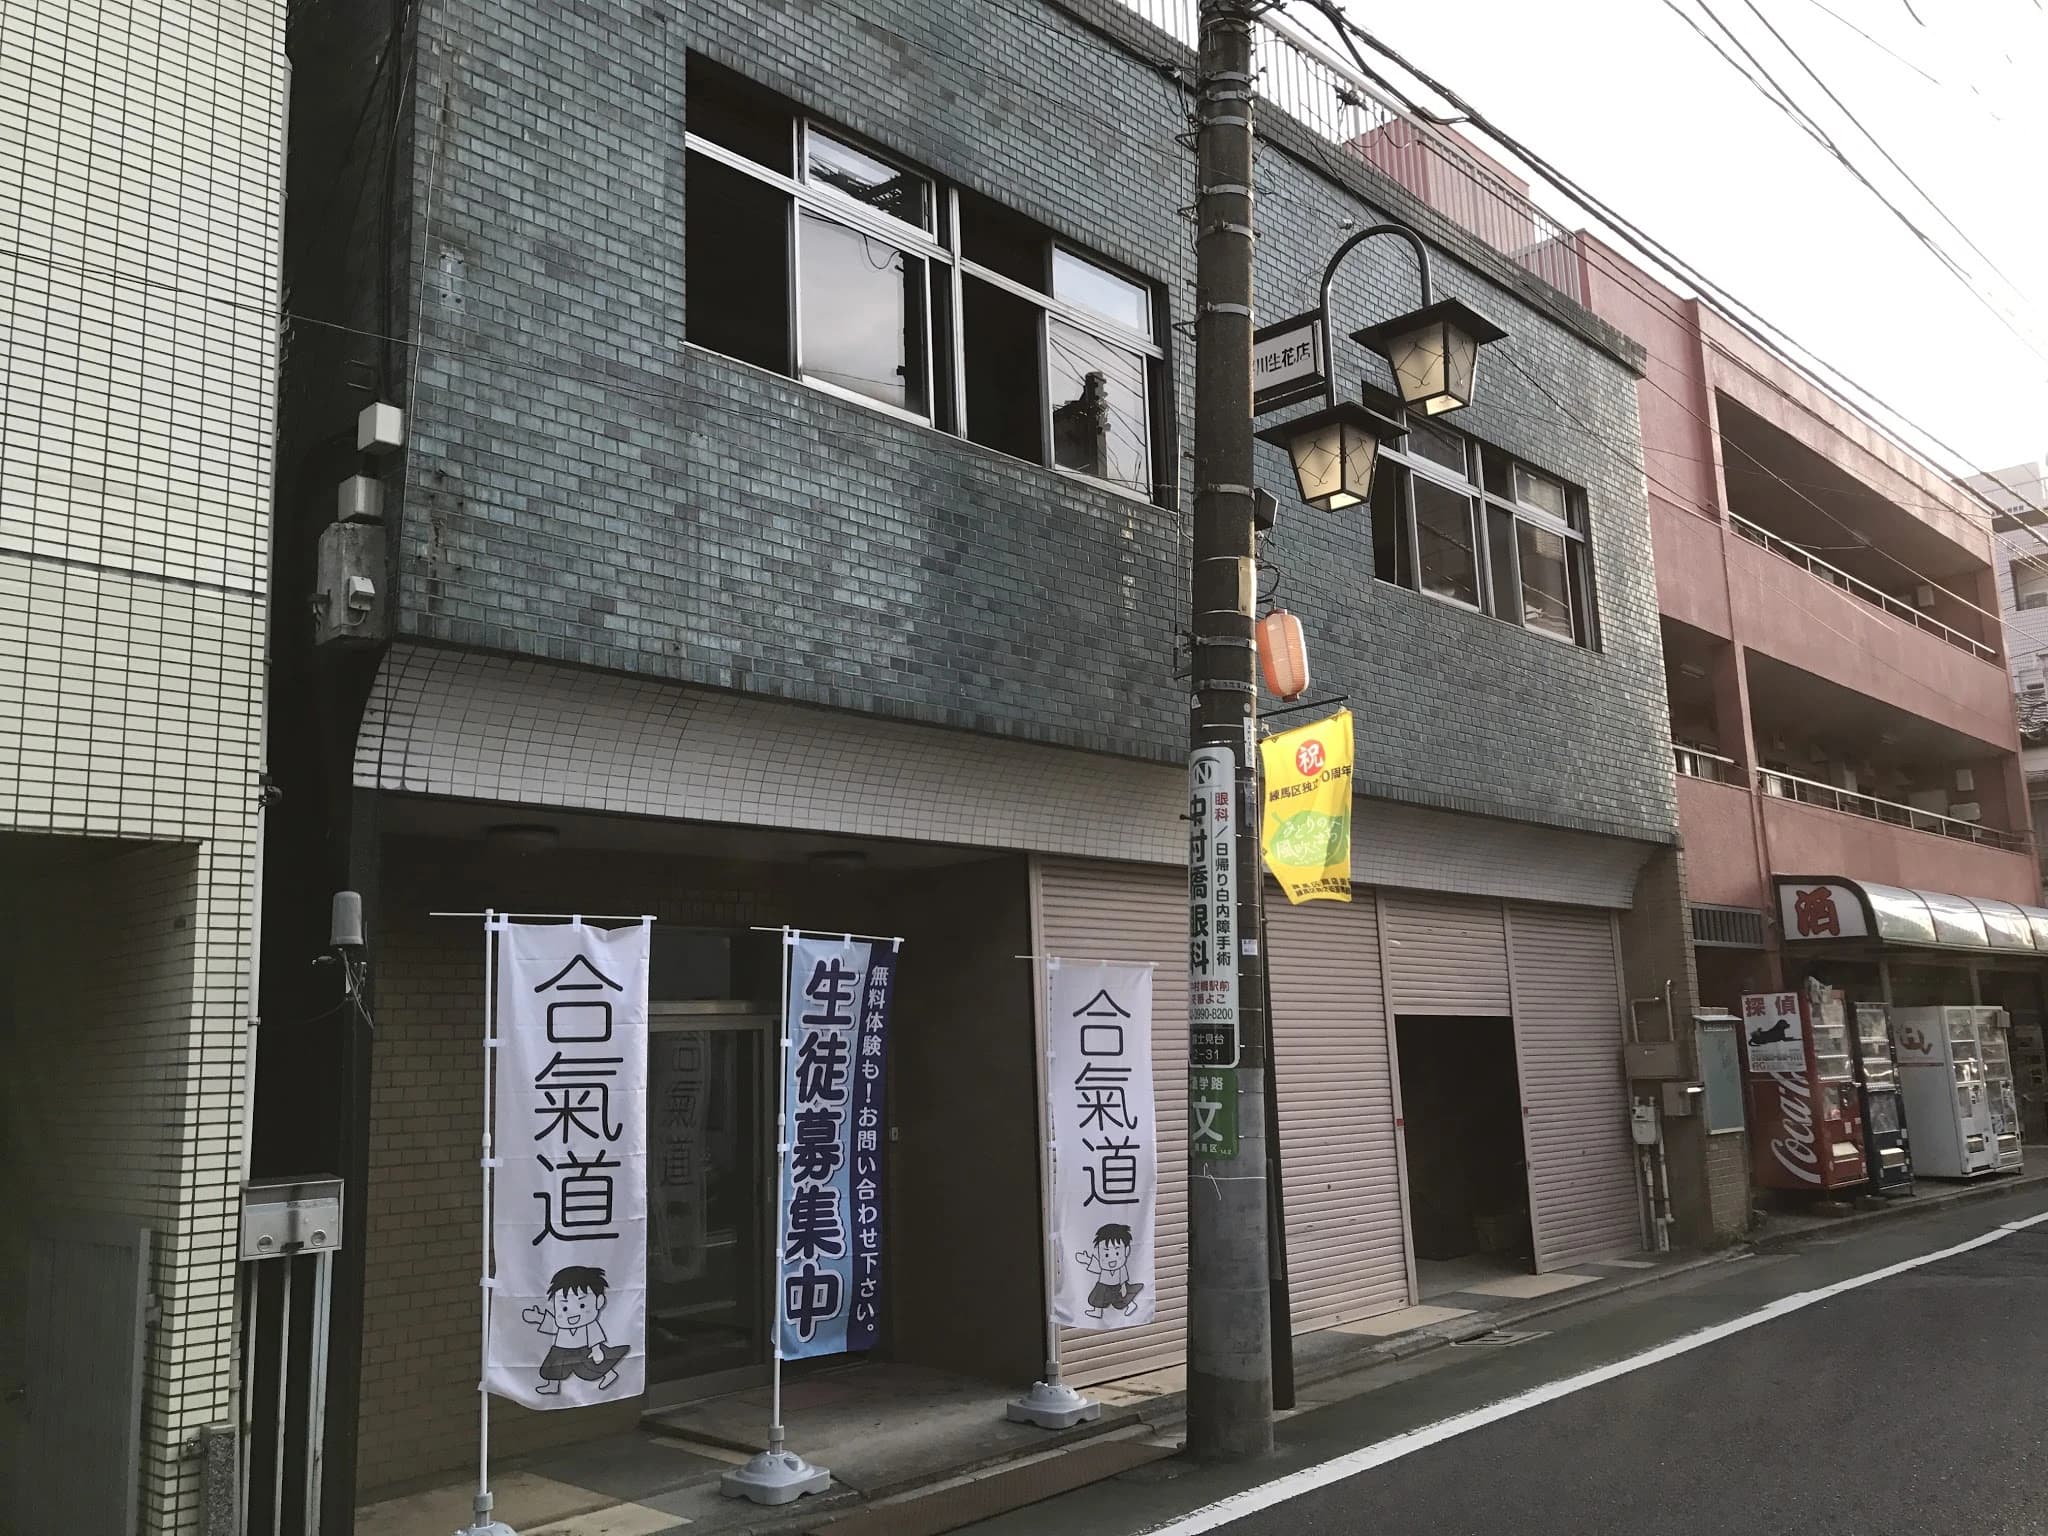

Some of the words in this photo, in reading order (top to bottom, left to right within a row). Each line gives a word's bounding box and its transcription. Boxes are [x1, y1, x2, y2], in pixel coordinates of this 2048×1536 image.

[1254, 342, 1311, 376] 川生花店
[1297, 743, 1323, 773] 祝
[1794, 886, 1841, 937] 酒
[1744, 995, 1797, 1017] 探偵
[532, 953, 624, 1247] 合氣道
[1072, 988, 1140, 1207] 合氣道
[1192, 1095, 1224, 1142] 文
[783, 957, 860, 1343] 生徒募集中
